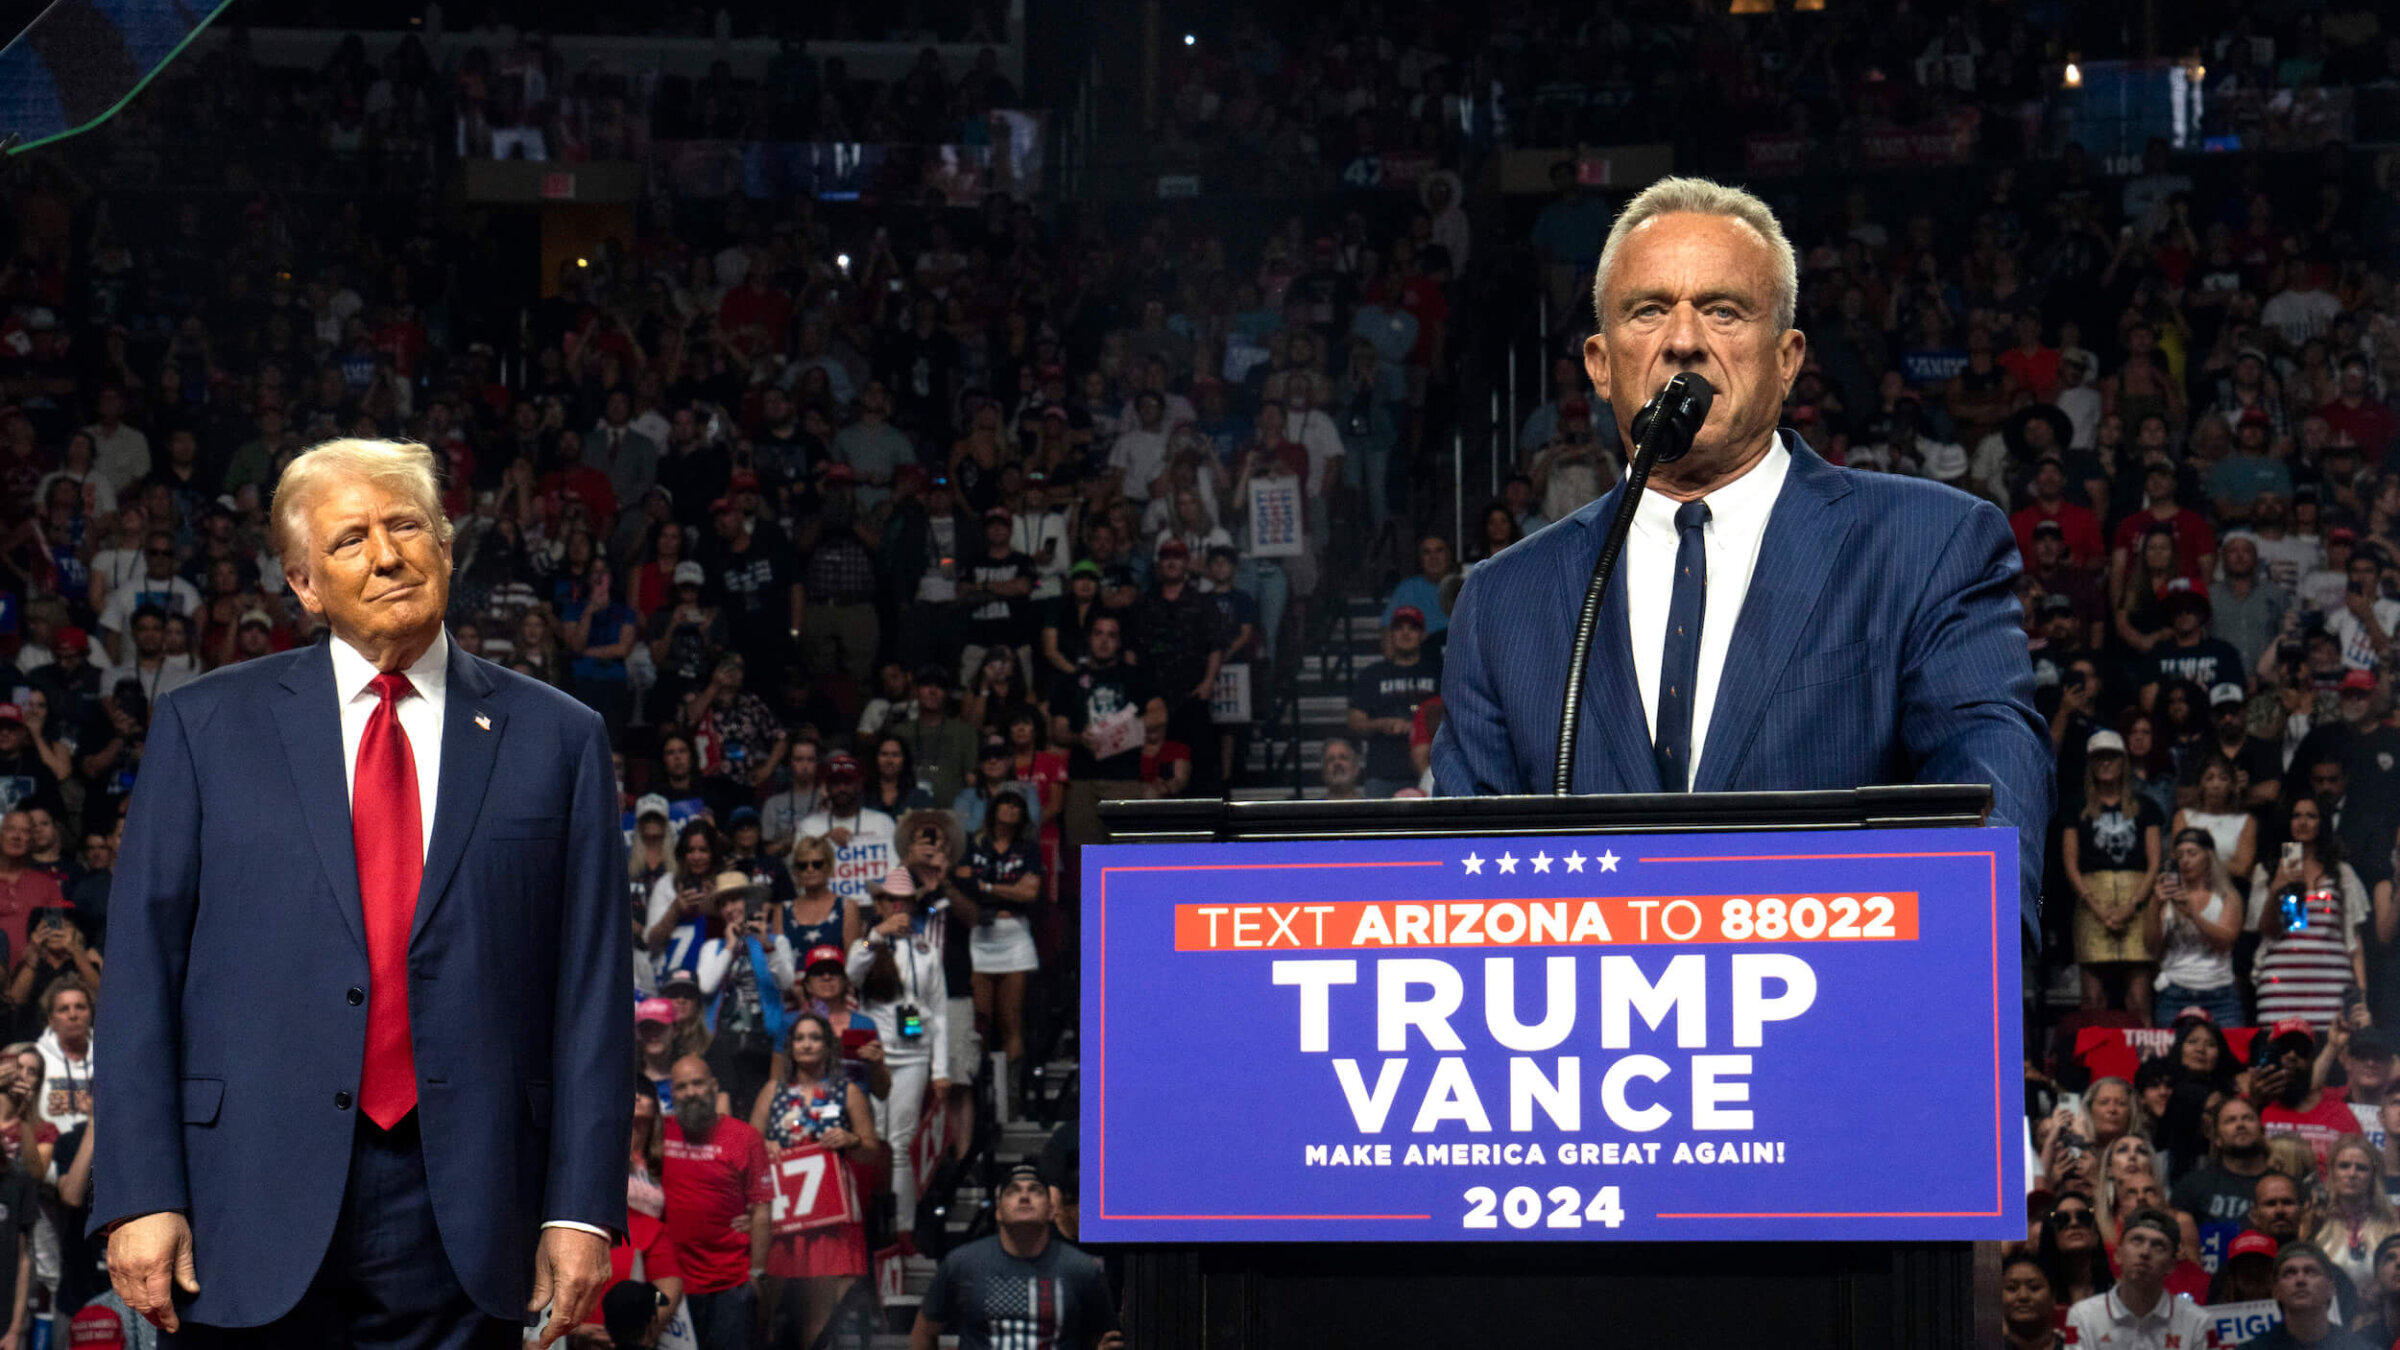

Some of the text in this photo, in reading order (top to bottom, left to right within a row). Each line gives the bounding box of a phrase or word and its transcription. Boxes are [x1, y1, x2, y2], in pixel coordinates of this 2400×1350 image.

[833, 860, 887, 878] GHT!
[1198, 896, 1895, 947] TEXT ARIZONA TO 88022
[1272, 953, 1817, 1052] TRUMP
[1332, 1054, 1754, 1133] VANCE
[1306, 1142, 1785, 1166] MAKE AMERICA GREAT AGAIN!
[1463, 1186, 1625, 1229] 2024
